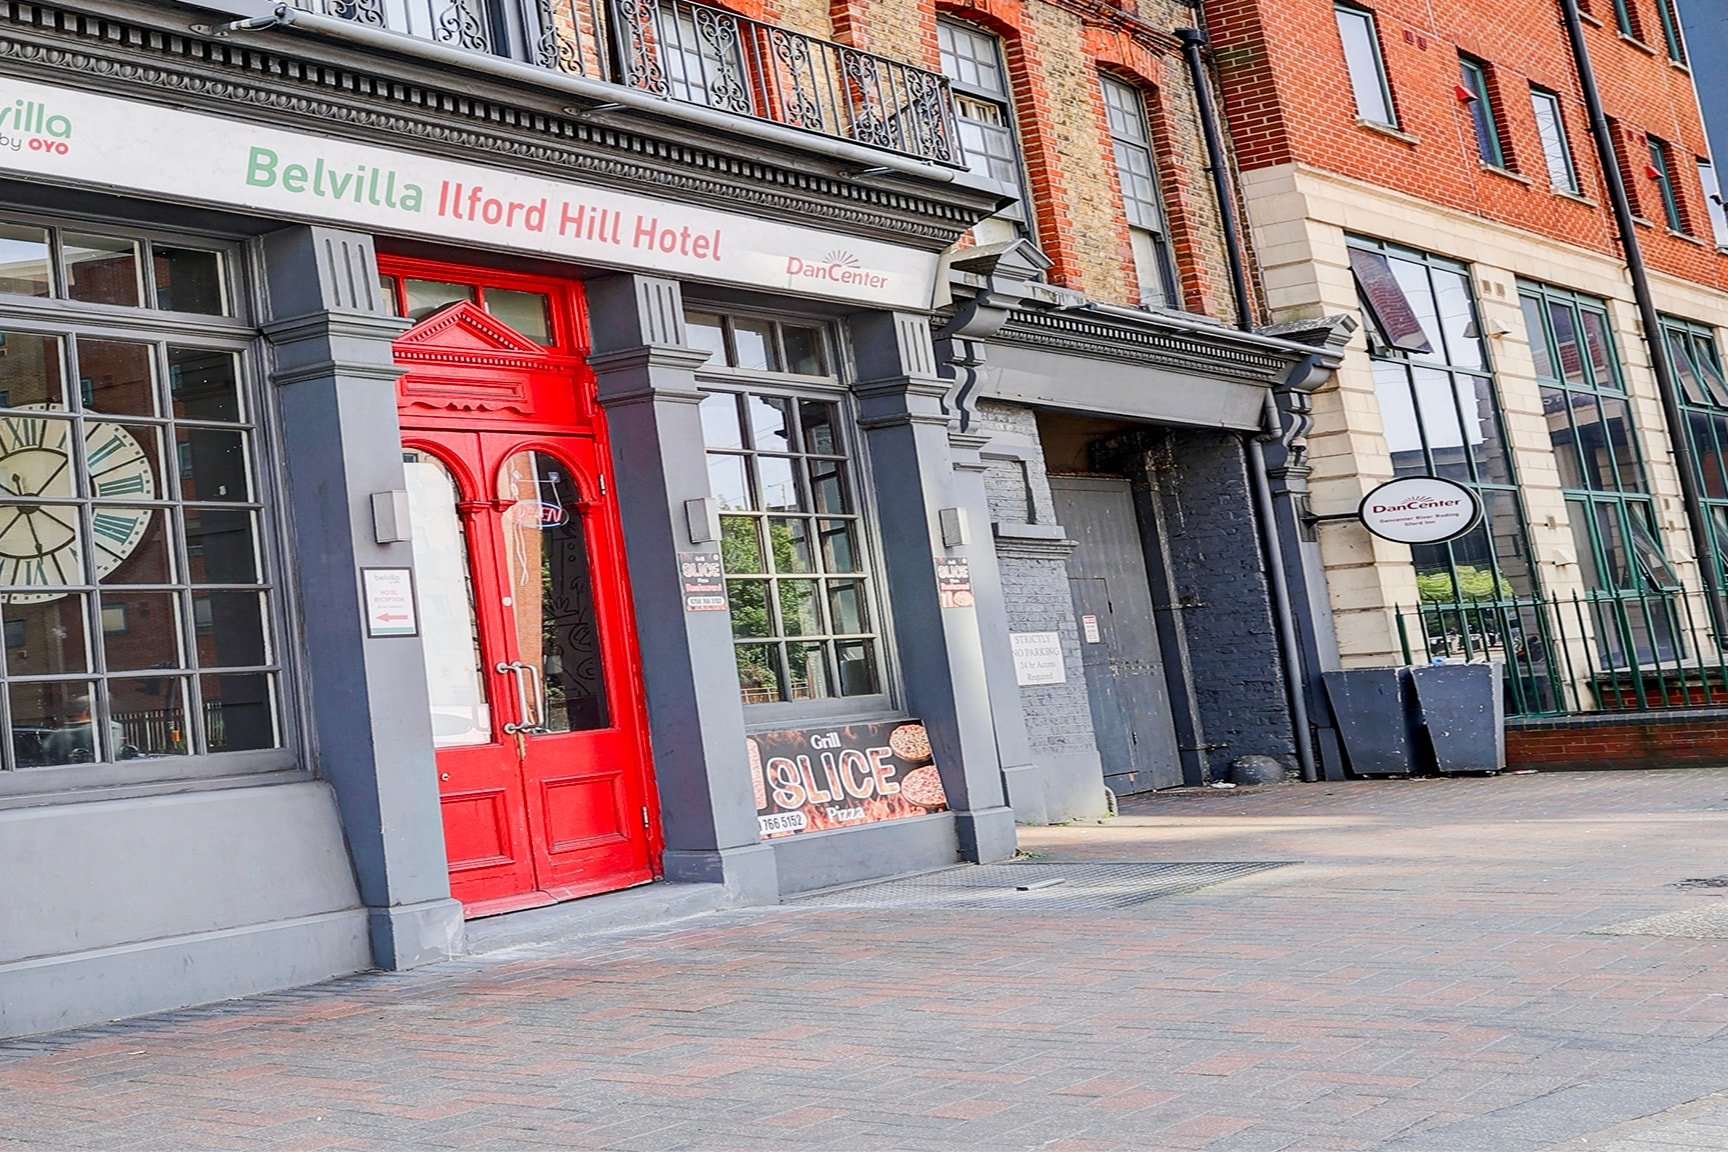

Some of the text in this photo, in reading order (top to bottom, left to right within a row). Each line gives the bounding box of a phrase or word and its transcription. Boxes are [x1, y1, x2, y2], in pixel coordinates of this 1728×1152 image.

[245, 145, 722, 261] Belvilla Ilford Hill Hotel
[785, 255, 888, 289] DanCenter
[1372, 499, 1462, 514] DanCenter
[681, 562, 721, 578] SLICE
[810, 731, 842, 749] Grill
[766, 746, 900, 810] SLICE
[762, 817, 780, 831] 766
[781, 814, 803, 828] 5152
[827, 805, 865, 823] Pizza
